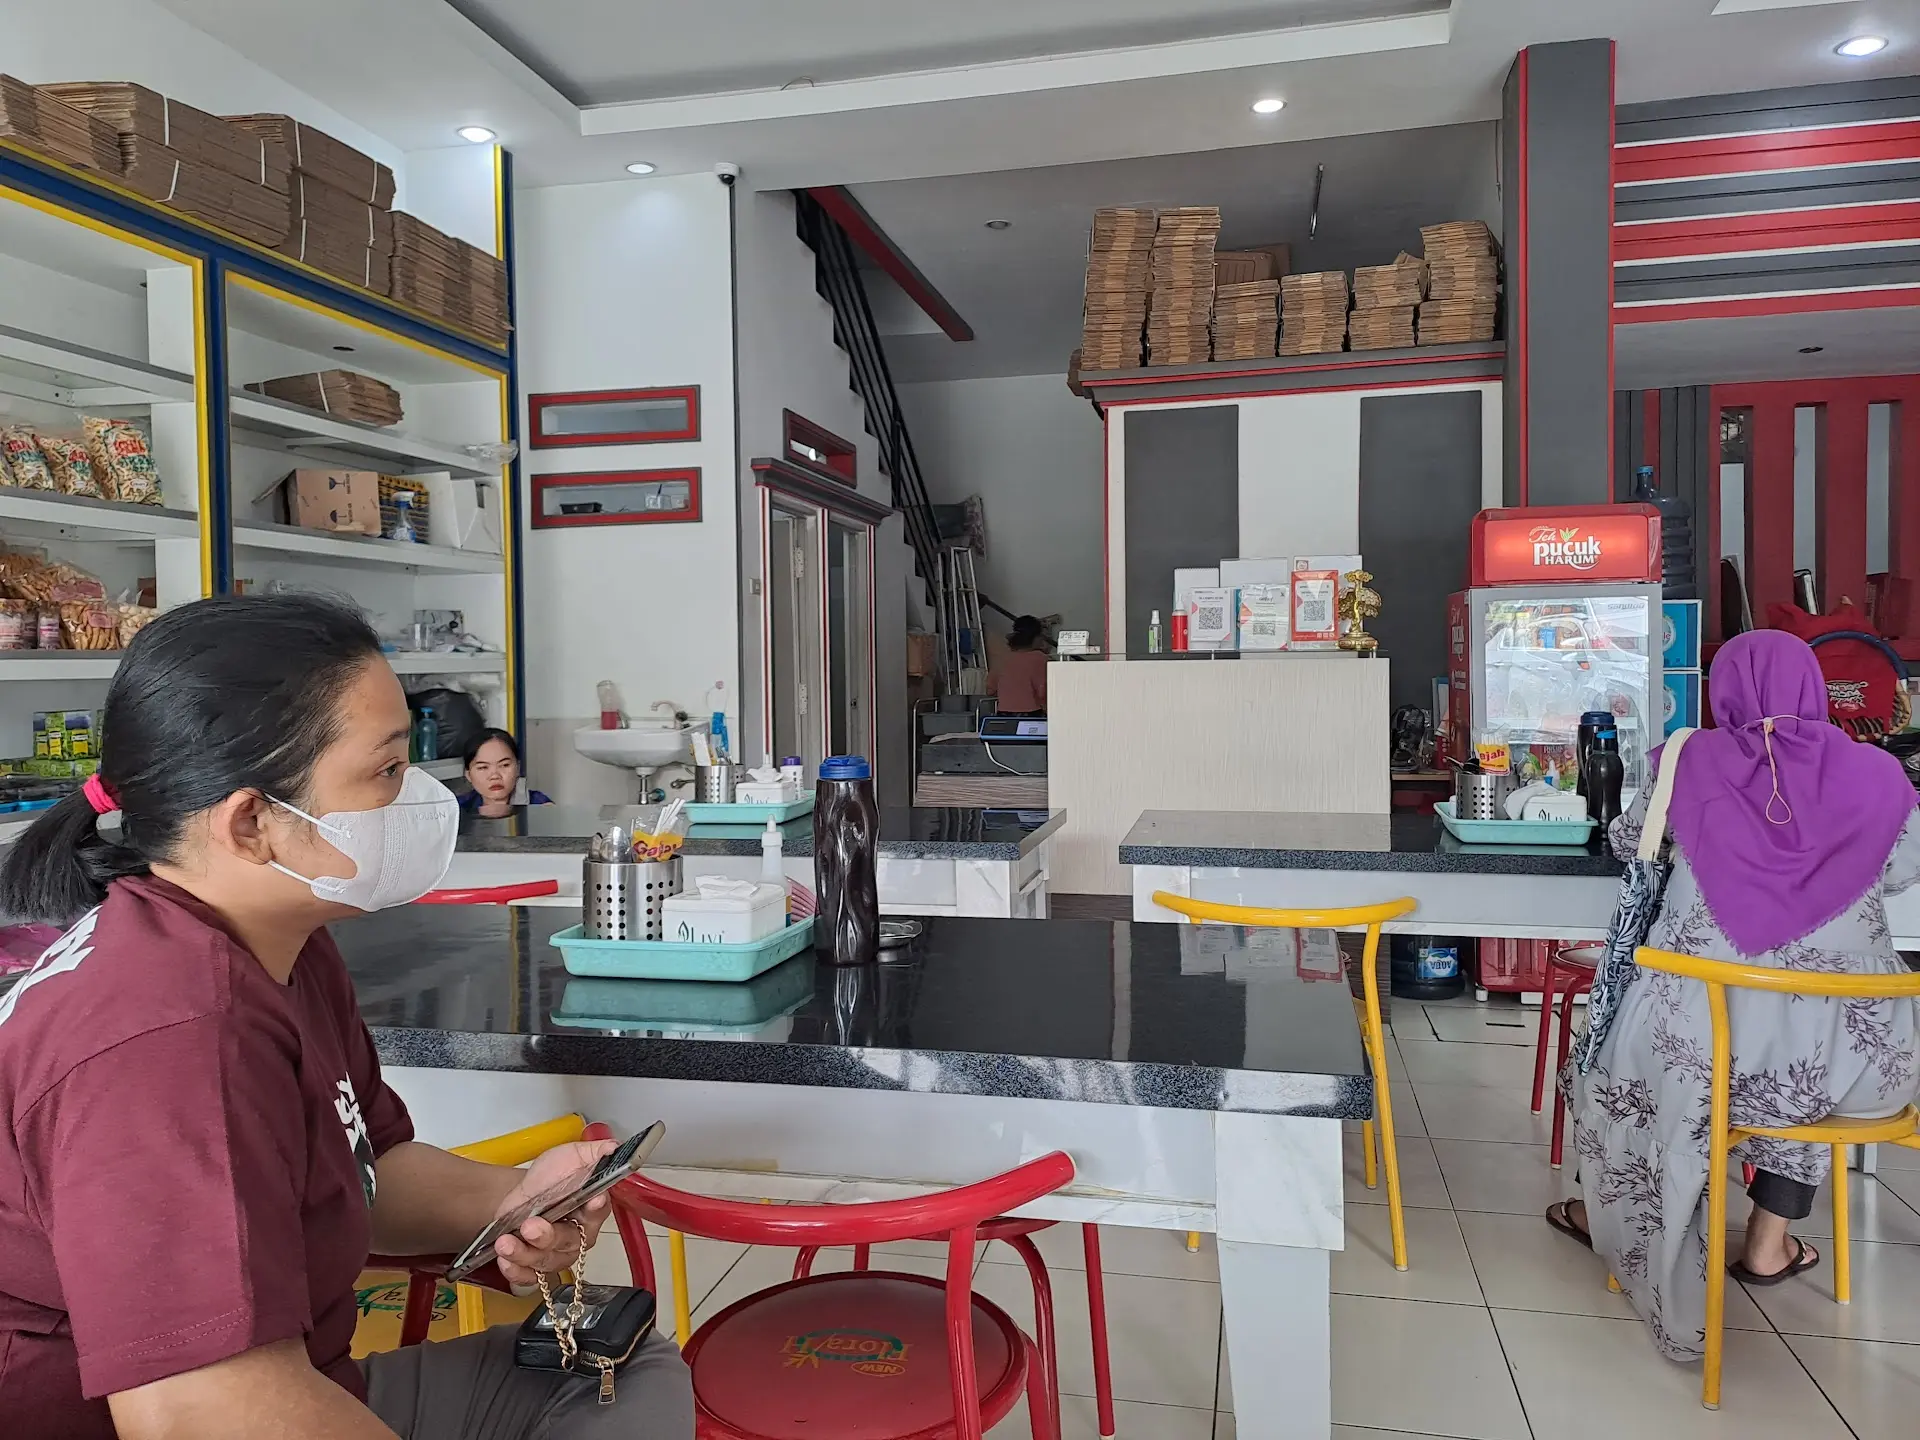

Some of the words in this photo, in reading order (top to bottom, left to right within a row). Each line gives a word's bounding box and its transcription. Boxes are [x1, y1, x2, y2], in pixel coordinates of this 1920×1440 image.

[1529, 529, 1557, 543] Teh
[1533, 535, 1602, 566] pucuk
[1545, 555, 1596, 566] HARUM
[1479, 748, 1505, 762] ajah
[633, 840, 678, 858] Gaja
[1428, 959, 1453, 971] AQUA
[859, 1363, 898, 1374] NEW
